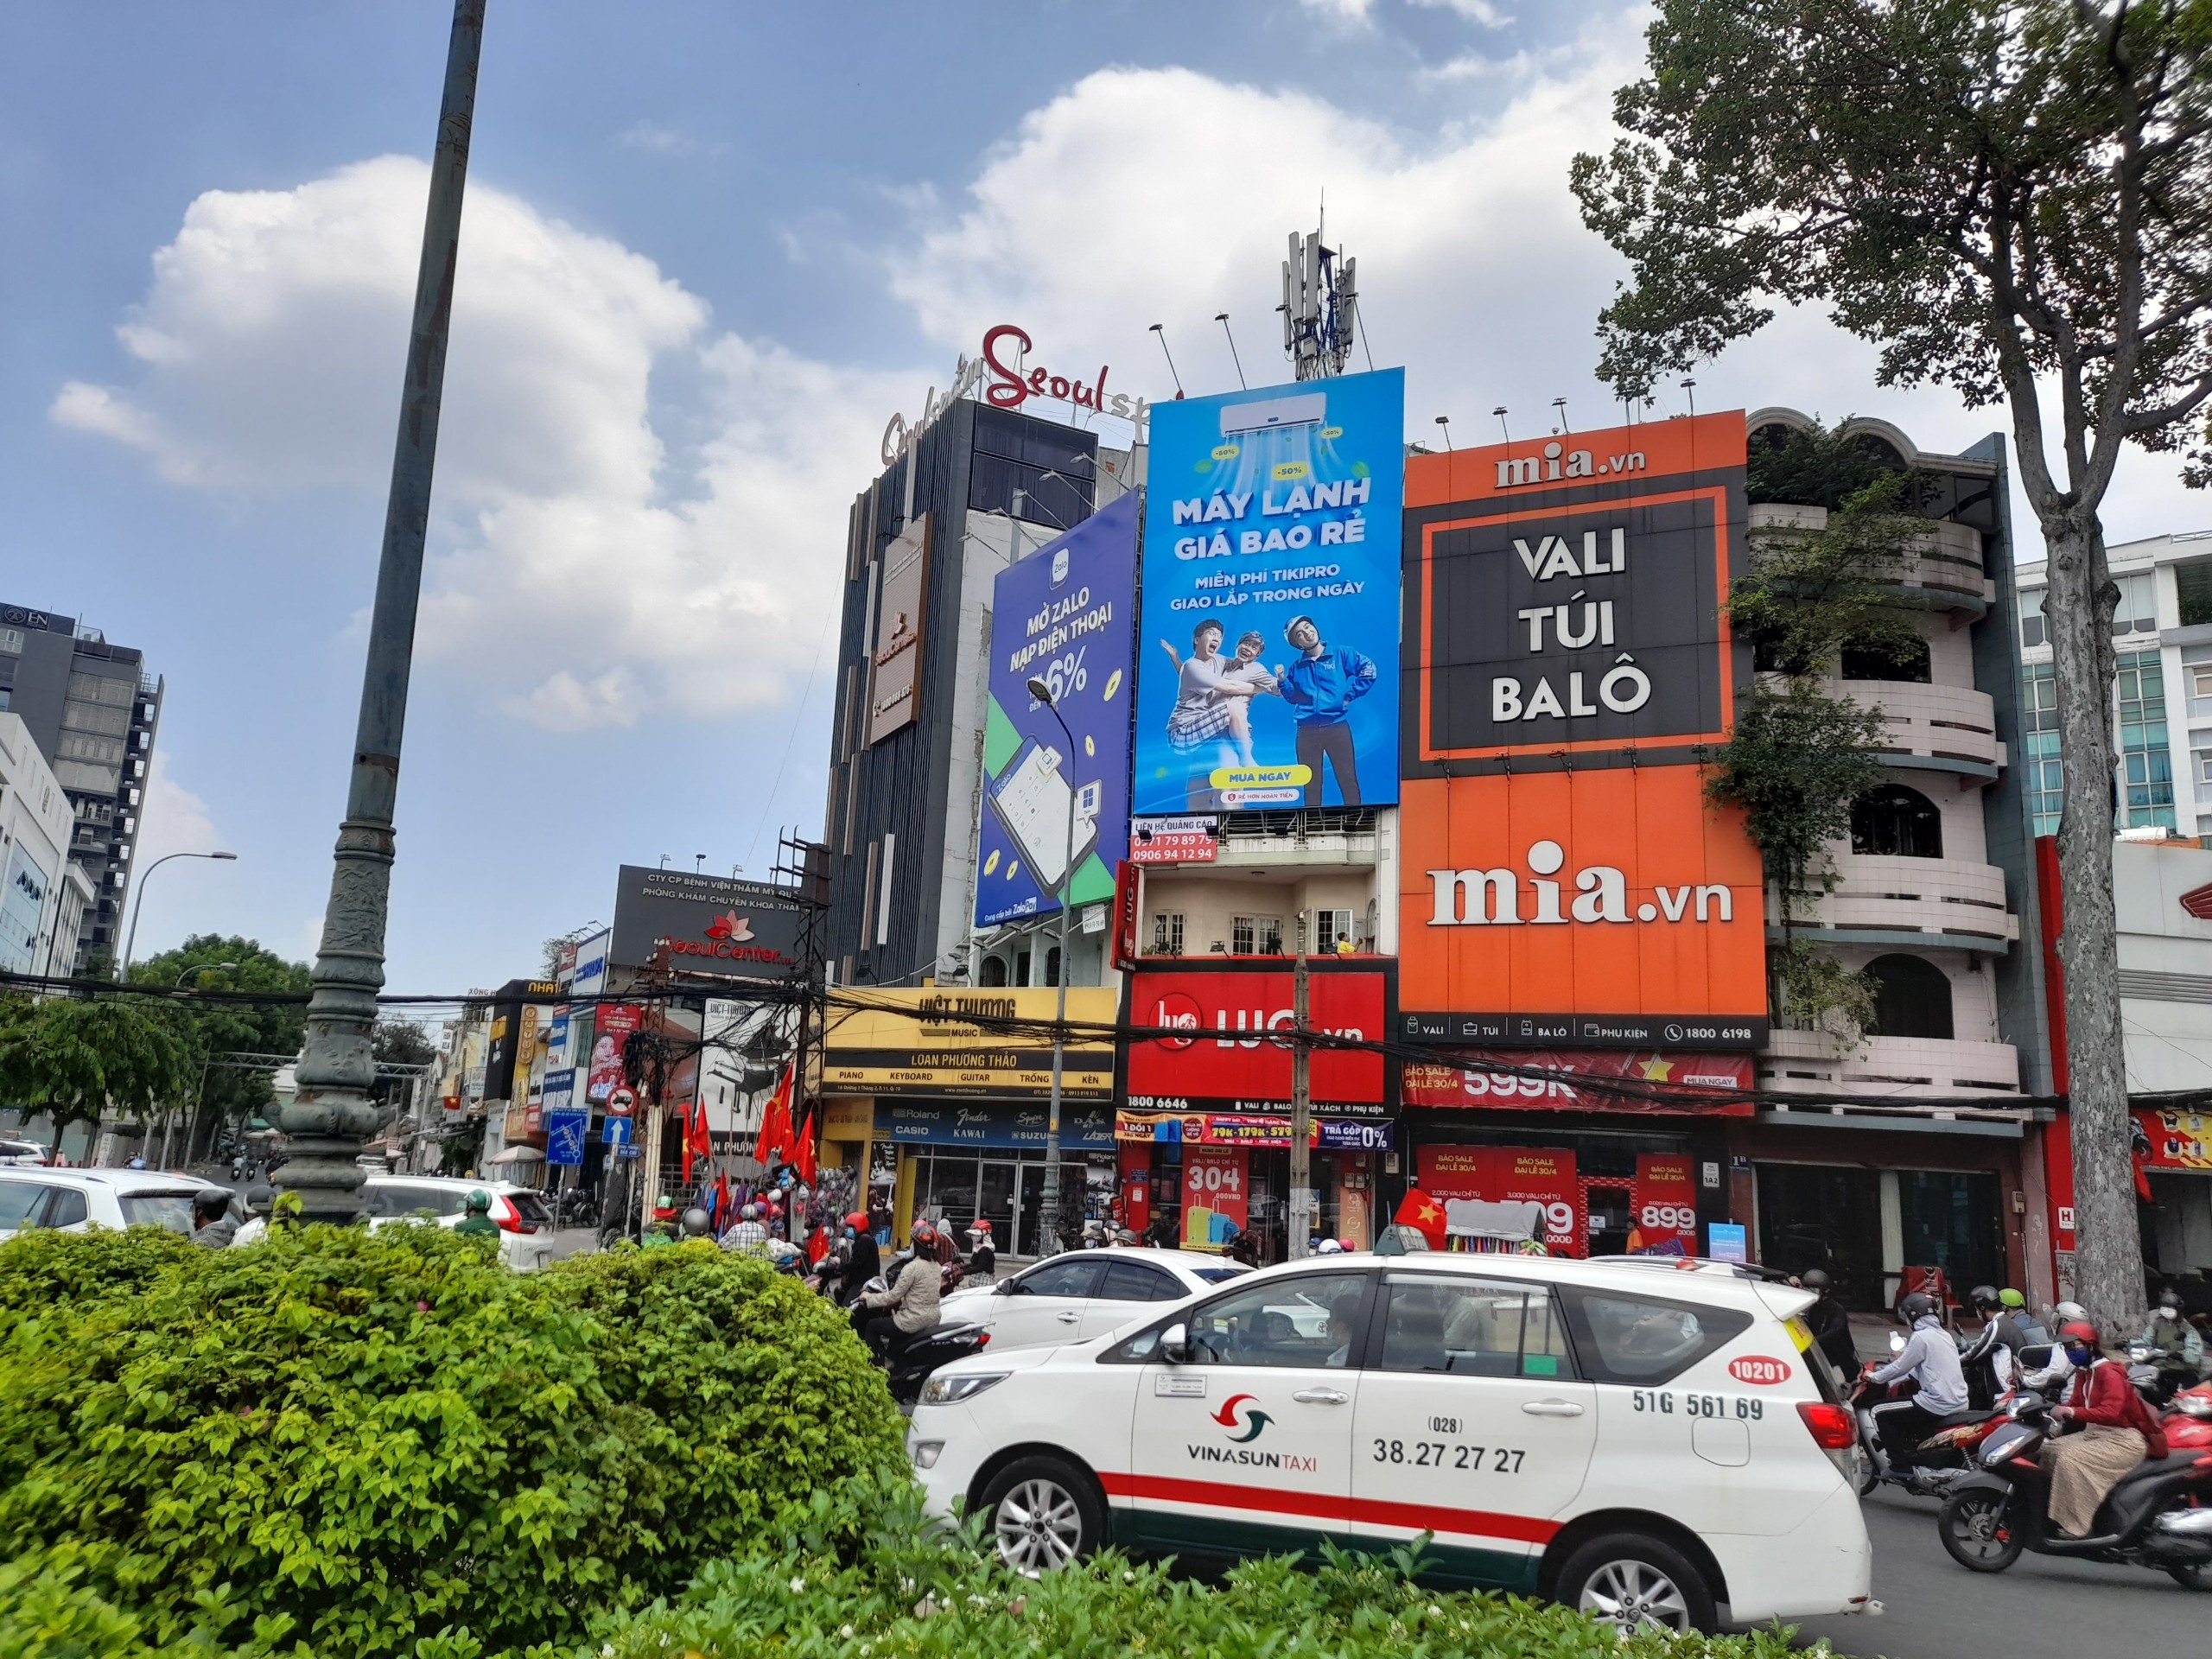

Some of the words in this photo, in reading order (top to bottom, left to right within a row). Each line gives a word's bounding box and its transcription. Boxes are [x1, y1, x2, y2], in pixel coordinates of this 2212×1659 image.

[983, 325, 1109, 407] Seoul
[1494, 442, 1646, 489] mia.vn
[1173, 488, 1253, 525] MÁY
[1262, 477, 1371, 518] LẠNH
[1174, 527, 1232, 560] GIÁ
[1240, 524, 1312, 554] BAO
[1320, 509, 1366, 546] RẺ
[1512, 527, 1626, 582] VALI
[1054, 560, 1067, 573] Zalo
[1195, 570, 1236, 589] MIỄN
[1241, 568, 1268, 584] PHÍ
[1272, 564, 1340, 582] TIKIPRO
[1170, 594, 1211, 611] GIAO
[1215, 589, 1249, 607] LẮP
[1253, 587, 1313, 604] TRONG
[1317, 581, 1365, 598] NGÀY
[1027, 602, 1050, 637] MỞ
[1052, 587, 1090, 623] ZALO
[1518, 588, 1614, 652] TÚI
[1010, 642, 1037, 673] NẠP
[1038, 626, 1067, 656] ĐIỆN
[1071, 601, 1112, 640] THOẠI
[1046, 645, 1087, 702] 6%
[1492, 652, 1651, 723] BALÔ
[995, 773, 1012, 794] Zalo
[1229, 772, 1255, 783] MUA
[1258, 772, 1291, 782] NGAY
[1135, 822, 1152, 831] LIÊN
[1154, 822, 1166, 832] HỆ
[1167, 820, 1194, 830] QUẢNG
[1166, 836, 1179, 846] 79
[1181, 836, 1196, 845] 89
[1198, 835, 1212, 845] 79
[1133, 850, 1161, 861] 0906
[1164, 849, 1178, 860] 94
[1182, 849, 1195, 859] 12
[1198, 849, 1212, 859] 94
[668, 875, 682, 884] CP
[683, 877, 708, 889] BỆNH
[711, 881, 731, 891] VIỆN
[1426, 839, 1733, 925] mia.vn
[643, 887, 676, 899] PHÒNG
[678, 892, 706, 901] KHÁM
[709, 896, 747, 906] CHUYÊN
[749, 900, 775, 910] KHOA
[1013, 897, 1037, 915] ZaloPay
[951, 1029, 978, 1038] MUSIC
[1422, 1027, 1444, 1035] VALI
[1482, 1024, 1498, 1036] TÚI
[1537, 1027, 1552, 1037] BA
[1553, 1025, 1567, 1037] LÔ
[1601, 1027, 1622, 1039] PHỤ
[1624, 1027, 1648, 1039] KIỆN
[1686, 1028, 1715, 1039] 1800
[1721, 1028, 1751, 1039] 6198
[941, 1052, 985, 1067] PHƯƠNG
[988, 1051, 1017, 1067] THẢO
[890, 1072, 933, 1081] KEYBOARD
[961, 1073, 990, 1082] GUITAR
[1020, 1071, 1049, 1084] TRỐNG
[1082, 1074, 1099, 1084] KÈN
[1425, 1067, 1451, 1076] SALE
[1432, 1080, 1459, 1089] 30/4
[1464, 1064, 1577, 1098] 599K
[1128, 1096, 1154, 1106] 1800
[1157, 1097, 1188, 1109] 6646
[1319, 1103, 1341, 1112] XÁCH
[1352, 1105, 1367, 1114] PHỤ
[1369, 1105, 1384, 1115] KIỆN
[906, 1109, 940, 1119] Roland
[957, 1109, 991, 1127] Fender
[895, 1125, 929, 1135] CASIO
[953, 1128, 985, 1139] KAWAI
[1211, 1127, 1233, 1137] 79K
[1238, 1127, 1266, 1137] 179K
[1324, 1124, 1341, 1135] TRẢ
[1343, 1125, 1361, 1135] GÓP
[1362, 1127, 1387, 1147] 0%
[1436, 1164, 1447, 1173] ĐẠI
[1515, 1166, 1527, 1175] ĐẠI
[1188, 1166, 1240, 1192] 304
[1642, 1205, 1696, 1229] 899
[1732, 1362, 1785, 1380] 10201
[1633, 1389, 1674, 1414] 51G
[1687, 1394, 1725, 1417] 561
[1736, 1397, 1764, 1421] 69
[1428, 1416, 1463, 1433] (028)
[1373, 1438, 1446, 1466] 38.27
[1454, 1445, 1485, 1470] 27
[1494, 1448, 1526, 1473] 27
